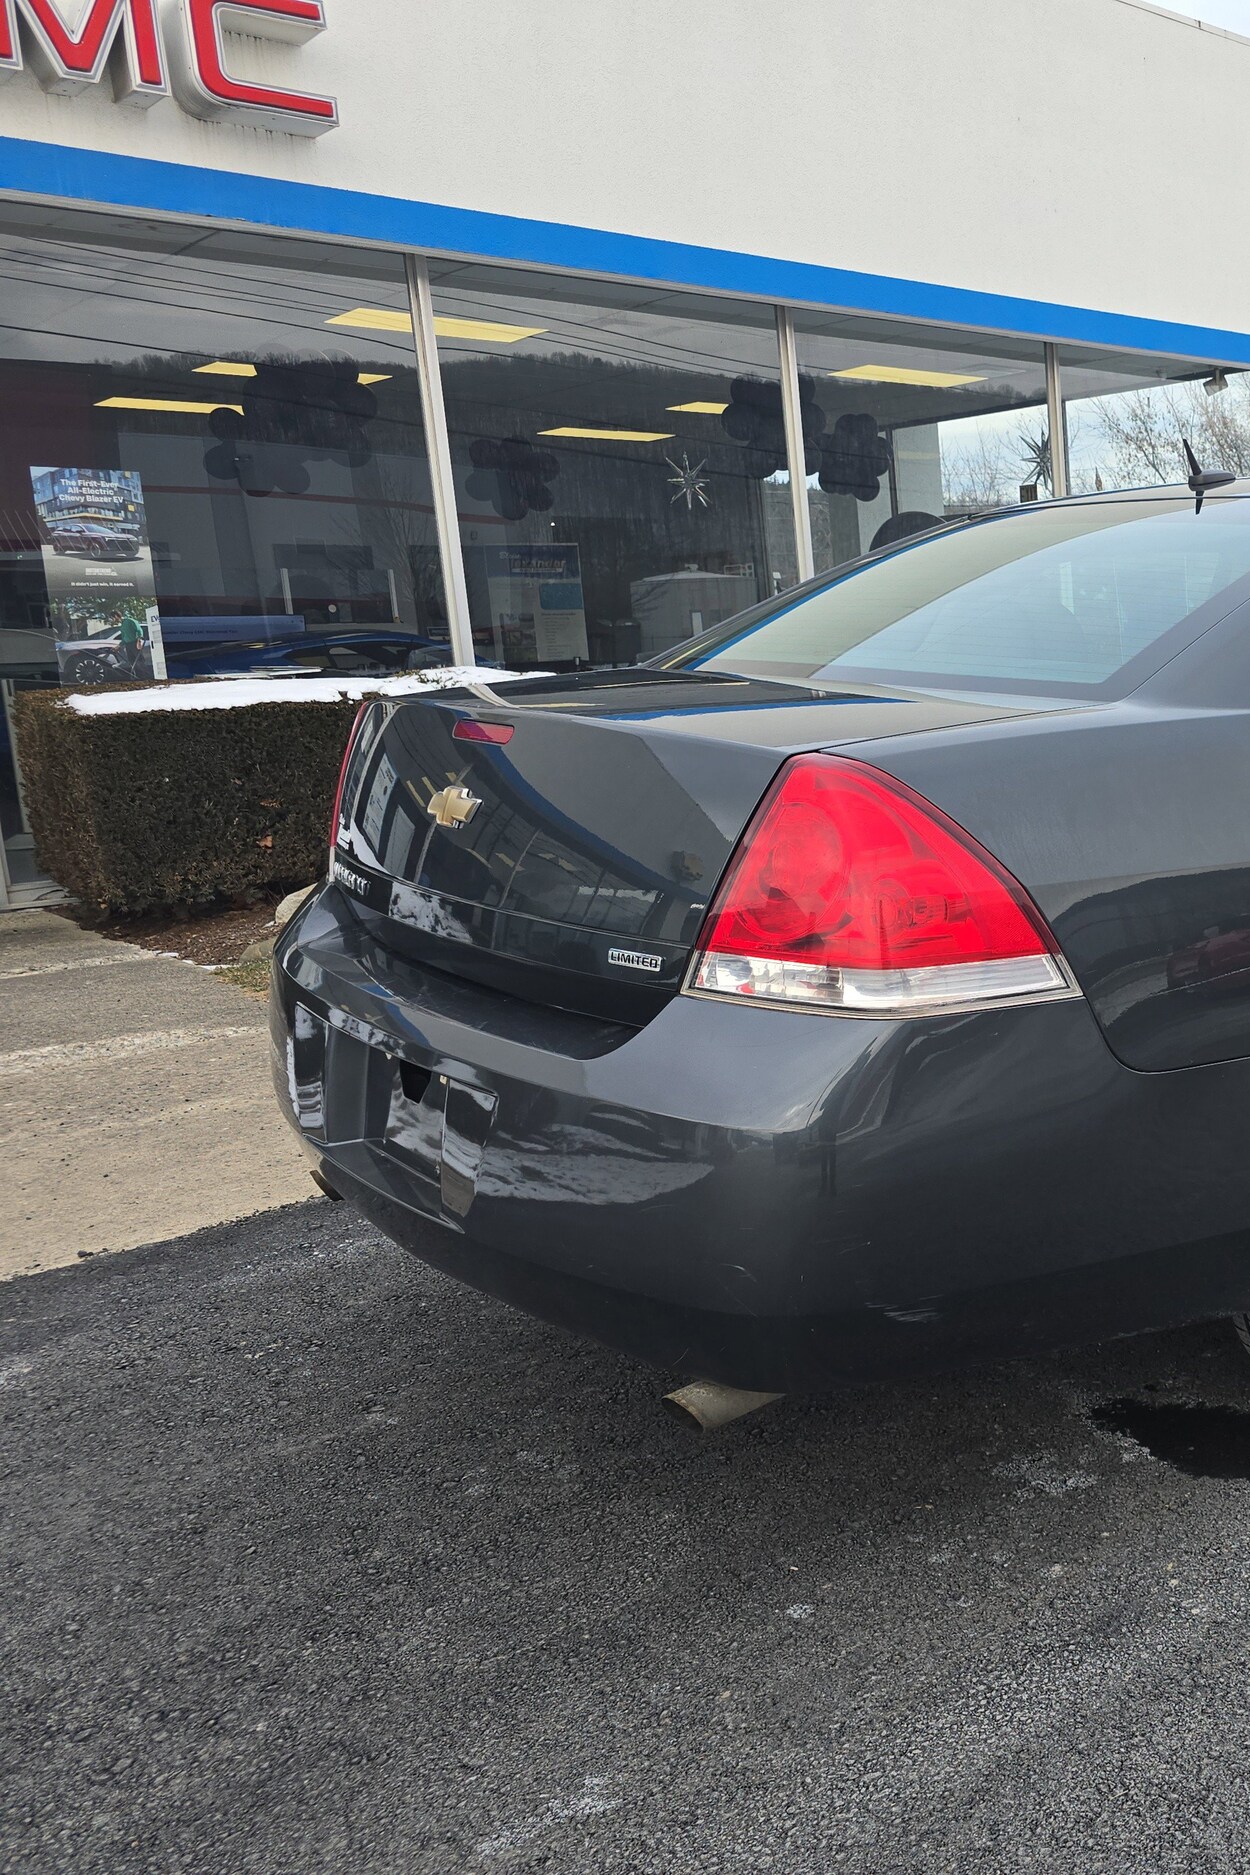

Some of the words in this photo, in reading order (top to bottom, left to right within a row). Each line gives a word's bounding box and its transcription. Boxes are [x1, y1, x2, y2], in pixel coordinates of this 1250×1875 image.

[60, 478, 77, 486] The
[78, 479, 118, 490] First-Ever
[67, 487, 115, 496] All-Electric
[59, 494, 85, 503] Chevy
[86, 495, 112, 503] Blazer
[113, 496, 124, 504] EV
[610, 951, 659, 969] LIMITED
